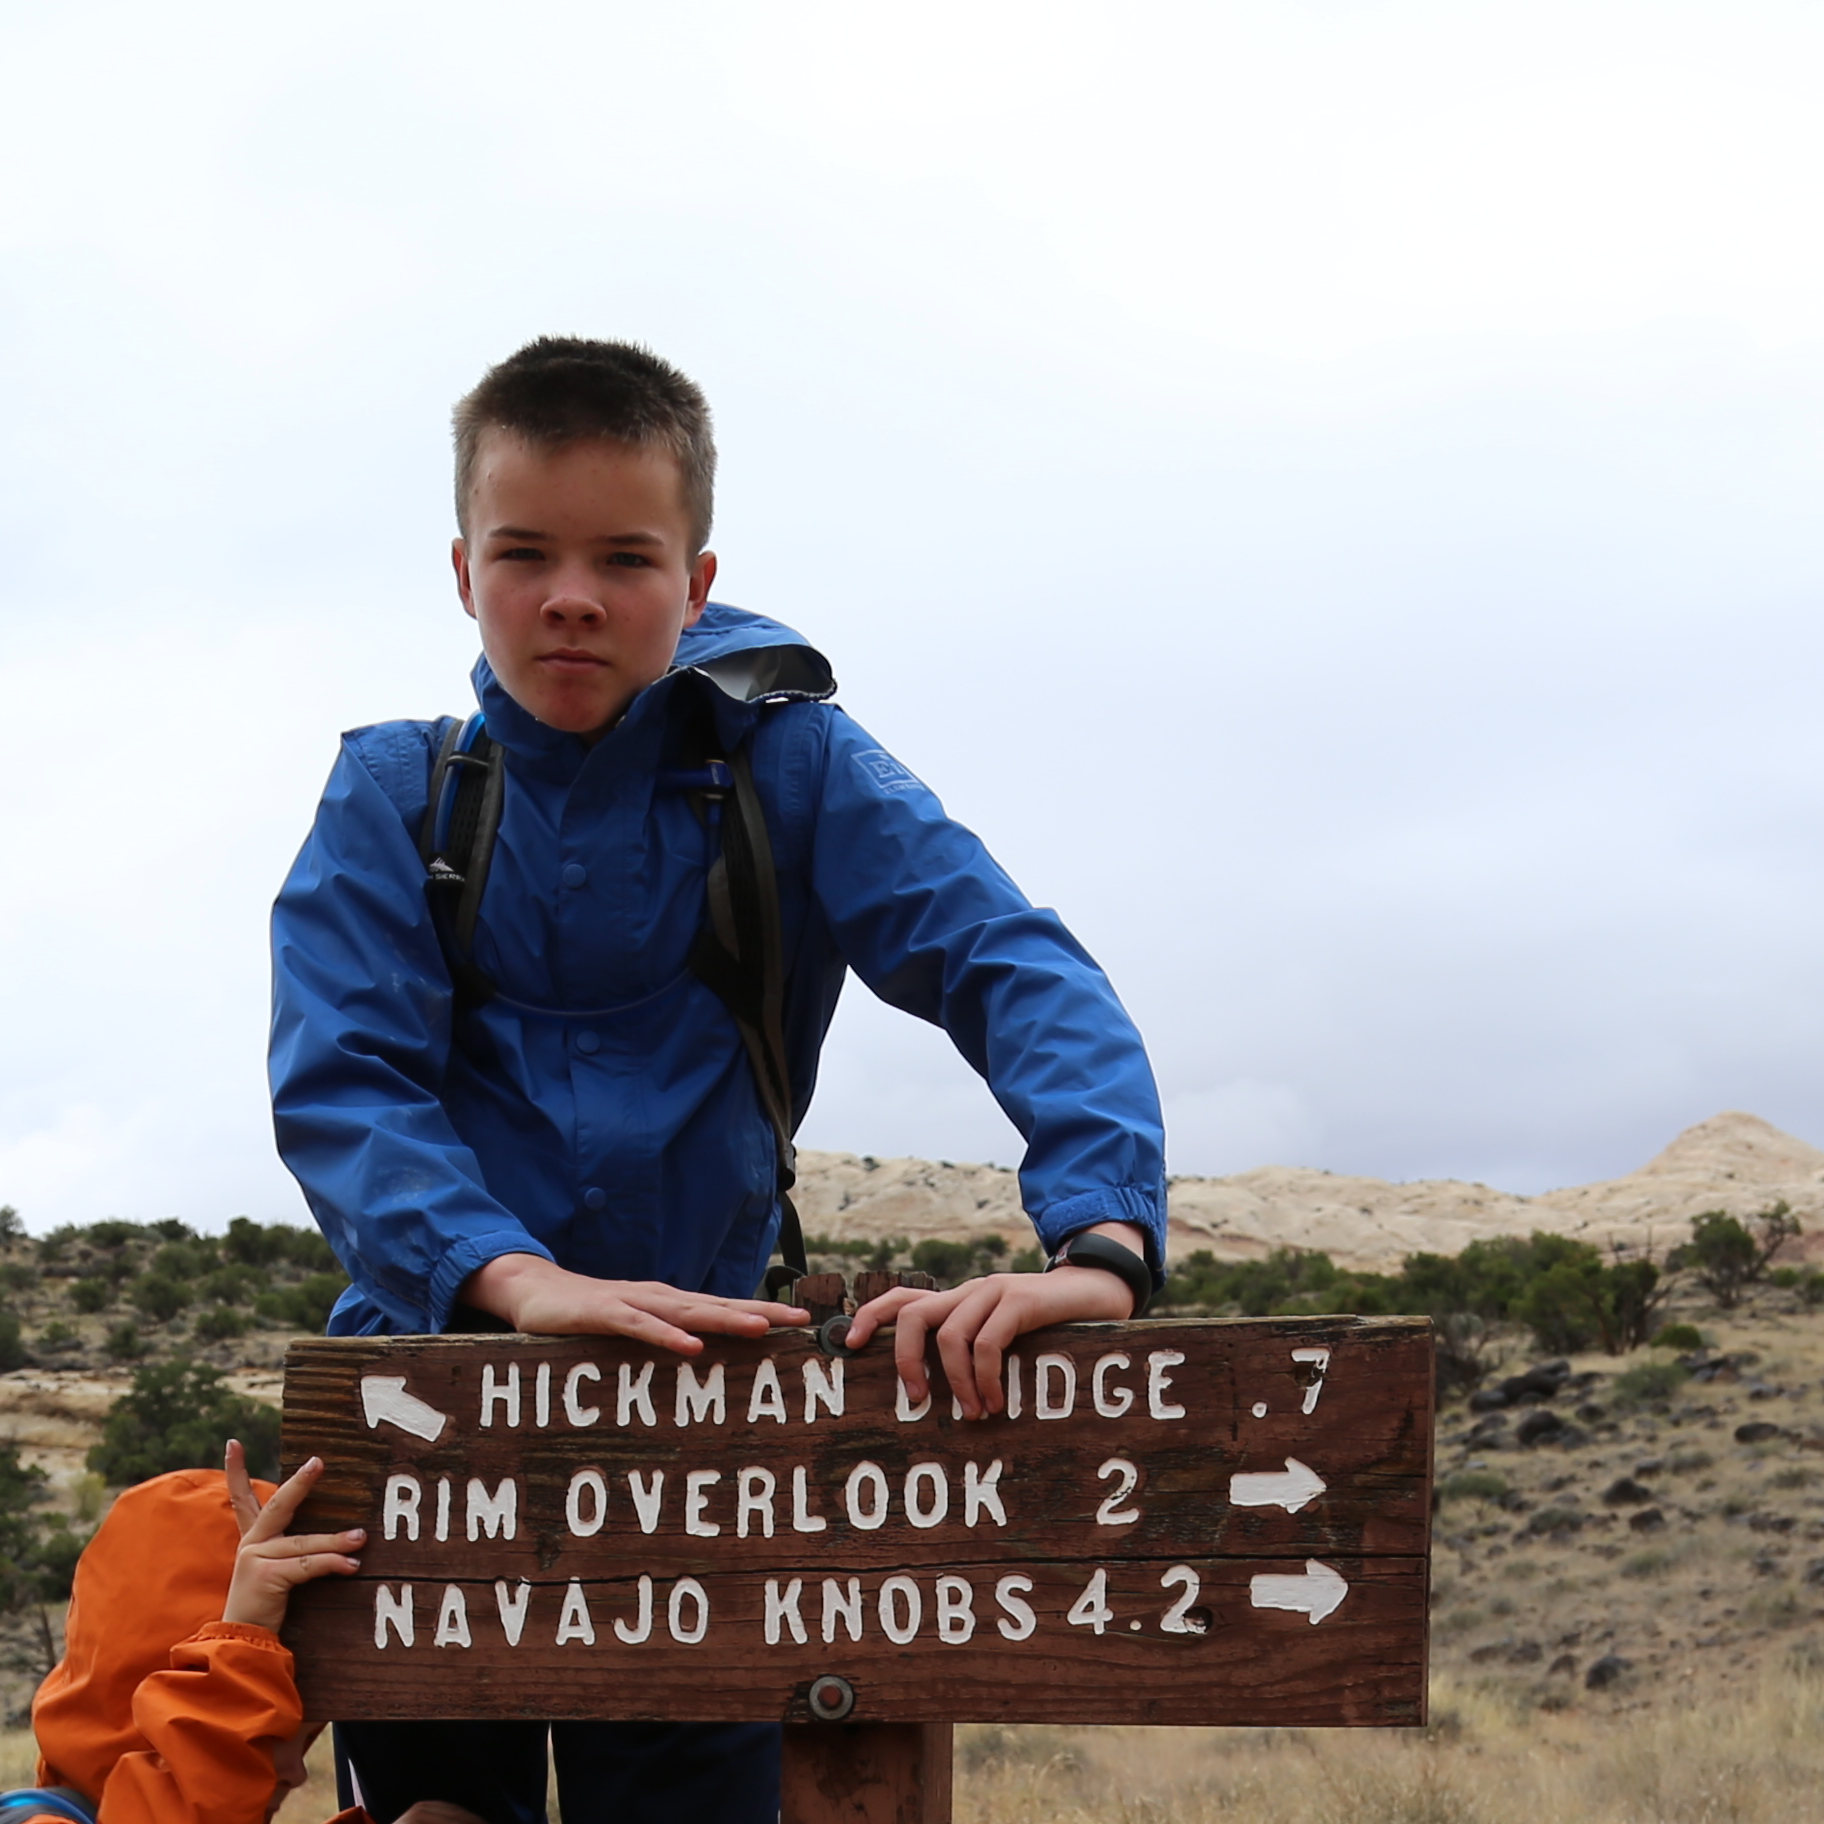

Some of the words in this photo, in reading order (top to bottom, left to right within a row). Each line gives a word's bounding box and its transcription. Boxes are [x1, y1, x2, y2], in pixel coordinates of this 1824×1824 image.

[478, 1356, 846, 1429] HICKMAN
[894, 1351, 1187, 1422] BIDGE
[1251, 1347, 1331, 1419] .7
[382, 1473, 518, 1543] RIM
[565, 1458, 1008, 1540] OVERLOOK
[1096, 1457, 1141, 1526] 2
[374, 1574, 709, 1650] NAVAJO
[764, 1574, 1037, 1646] KNOBS
[1066, 1564, 1209, 1636] 4.2
